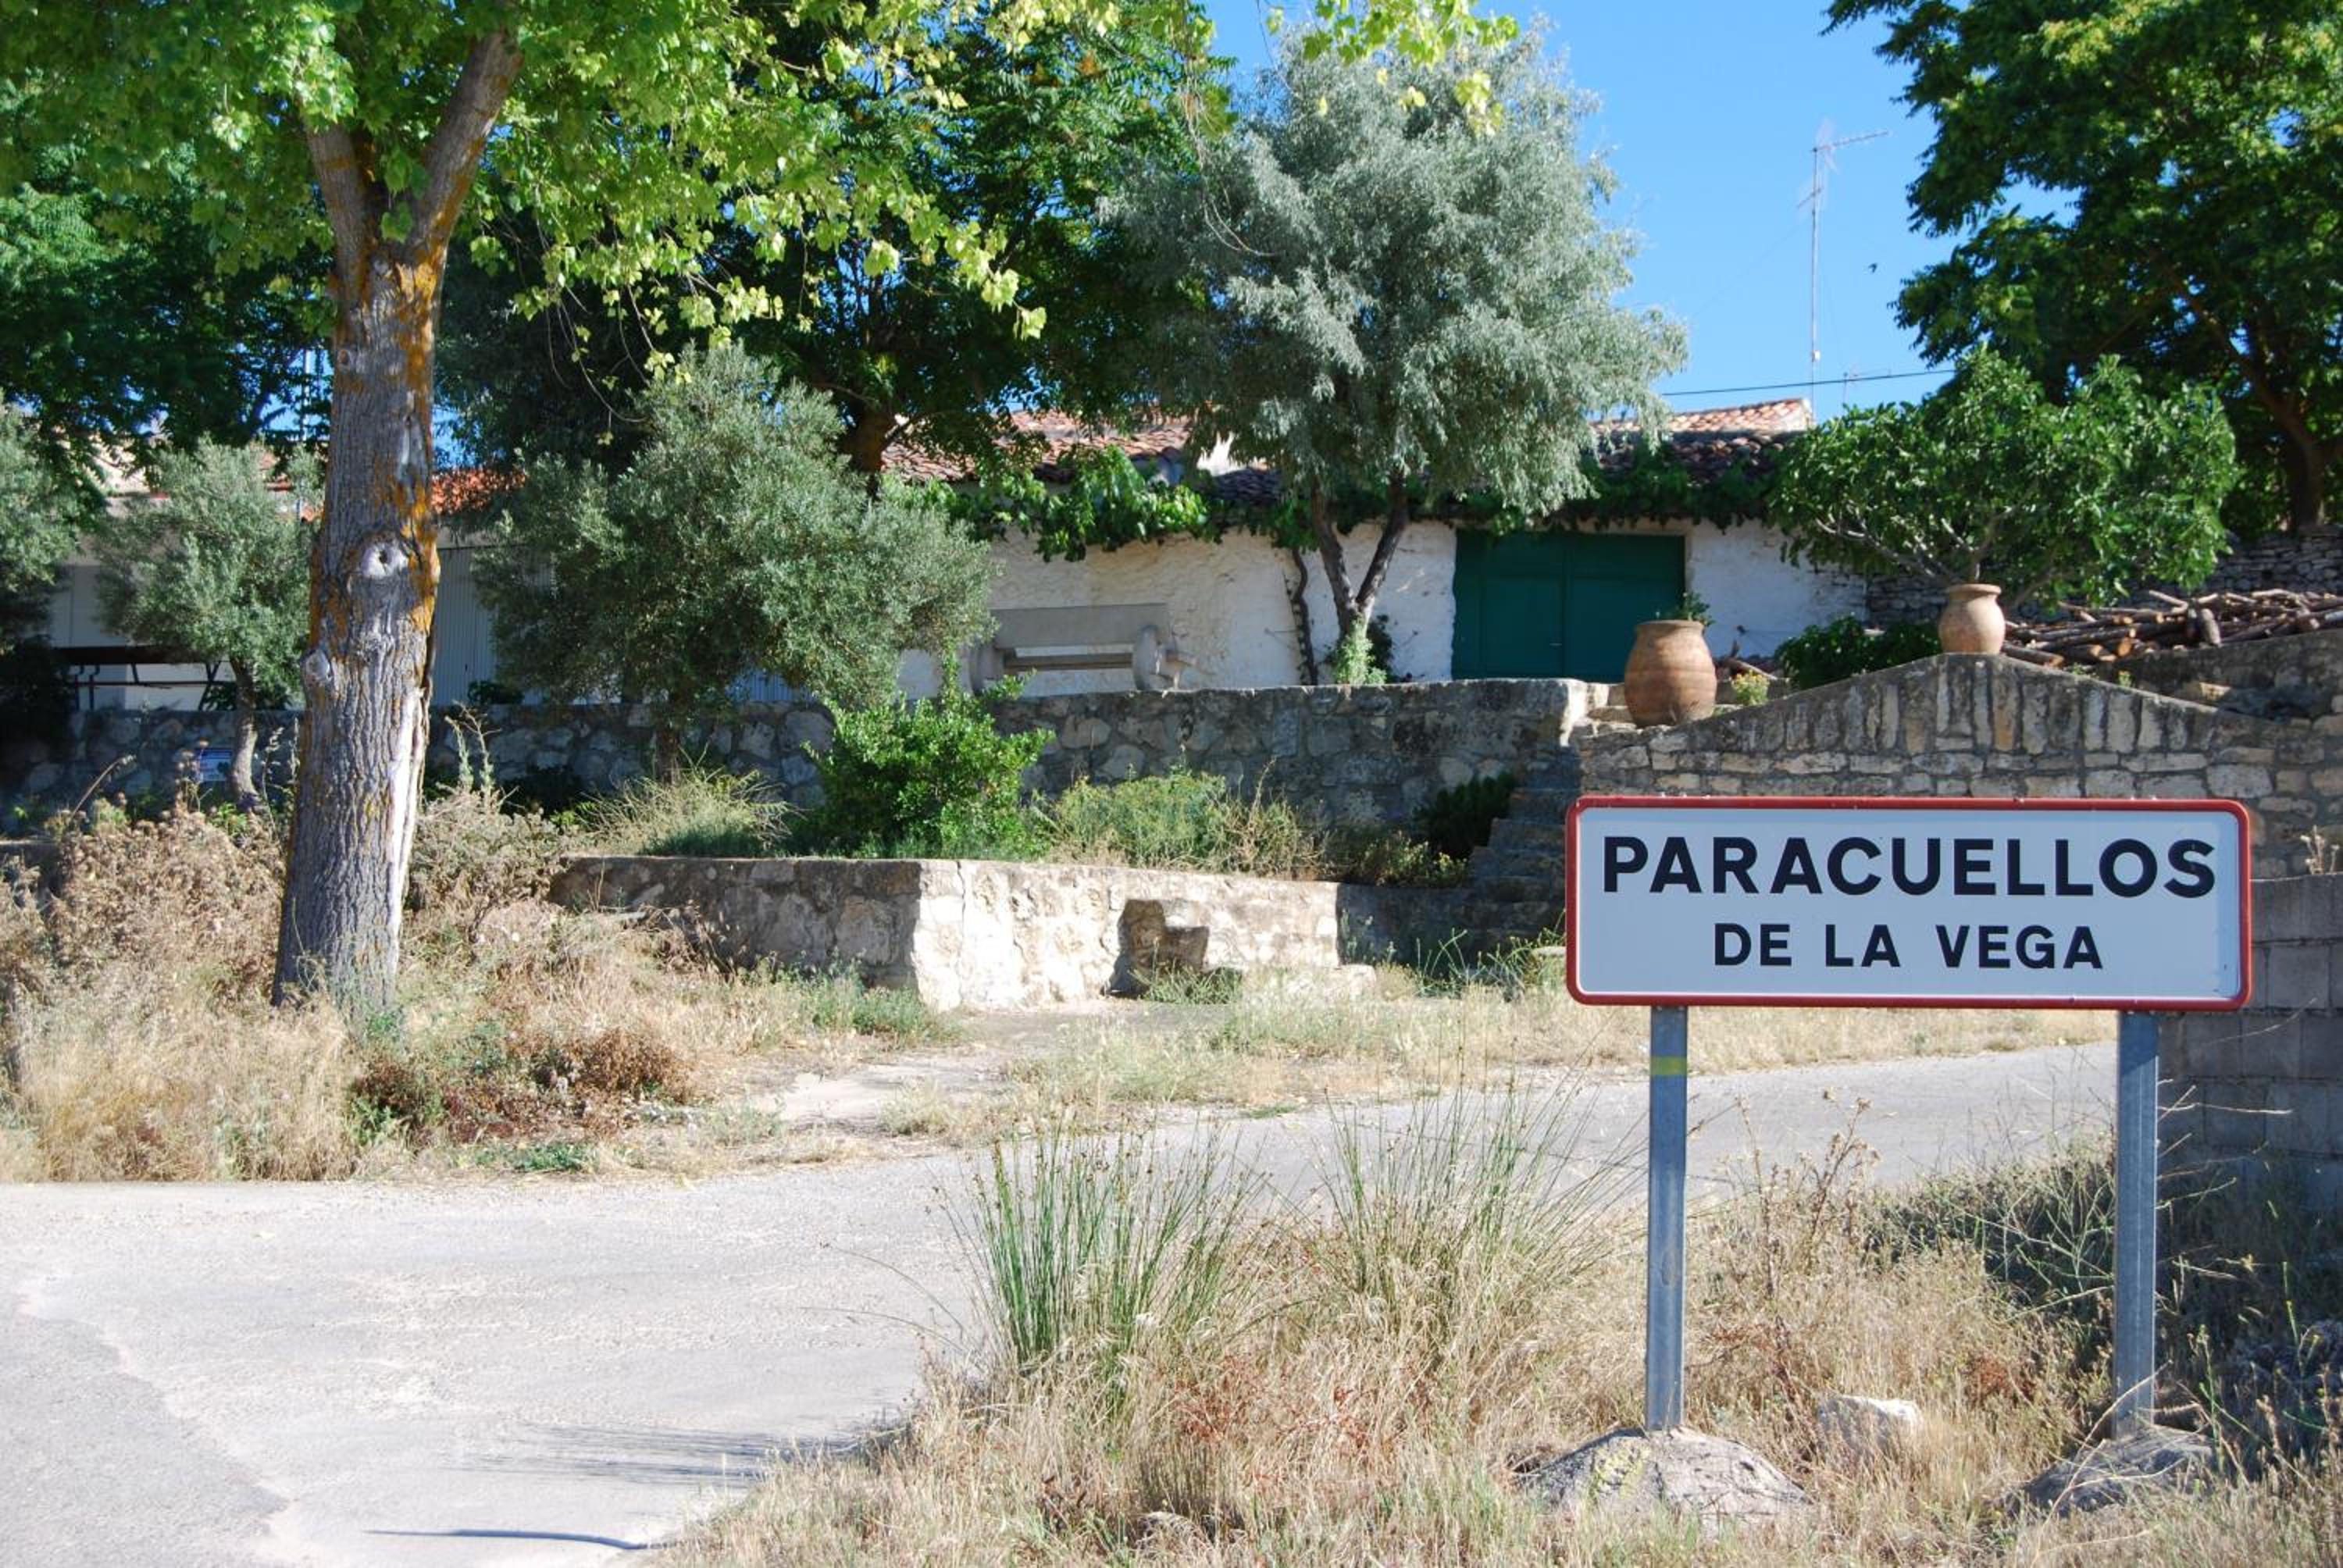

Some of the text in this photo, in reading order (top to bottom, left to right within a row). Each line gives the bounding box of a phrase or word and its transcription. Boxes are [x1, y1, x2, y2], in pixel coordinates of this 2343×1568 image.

[1603, 836, 2216, 899] PARACUELLOS
[1714, 922, 2103, 970] DE LA VEGA
